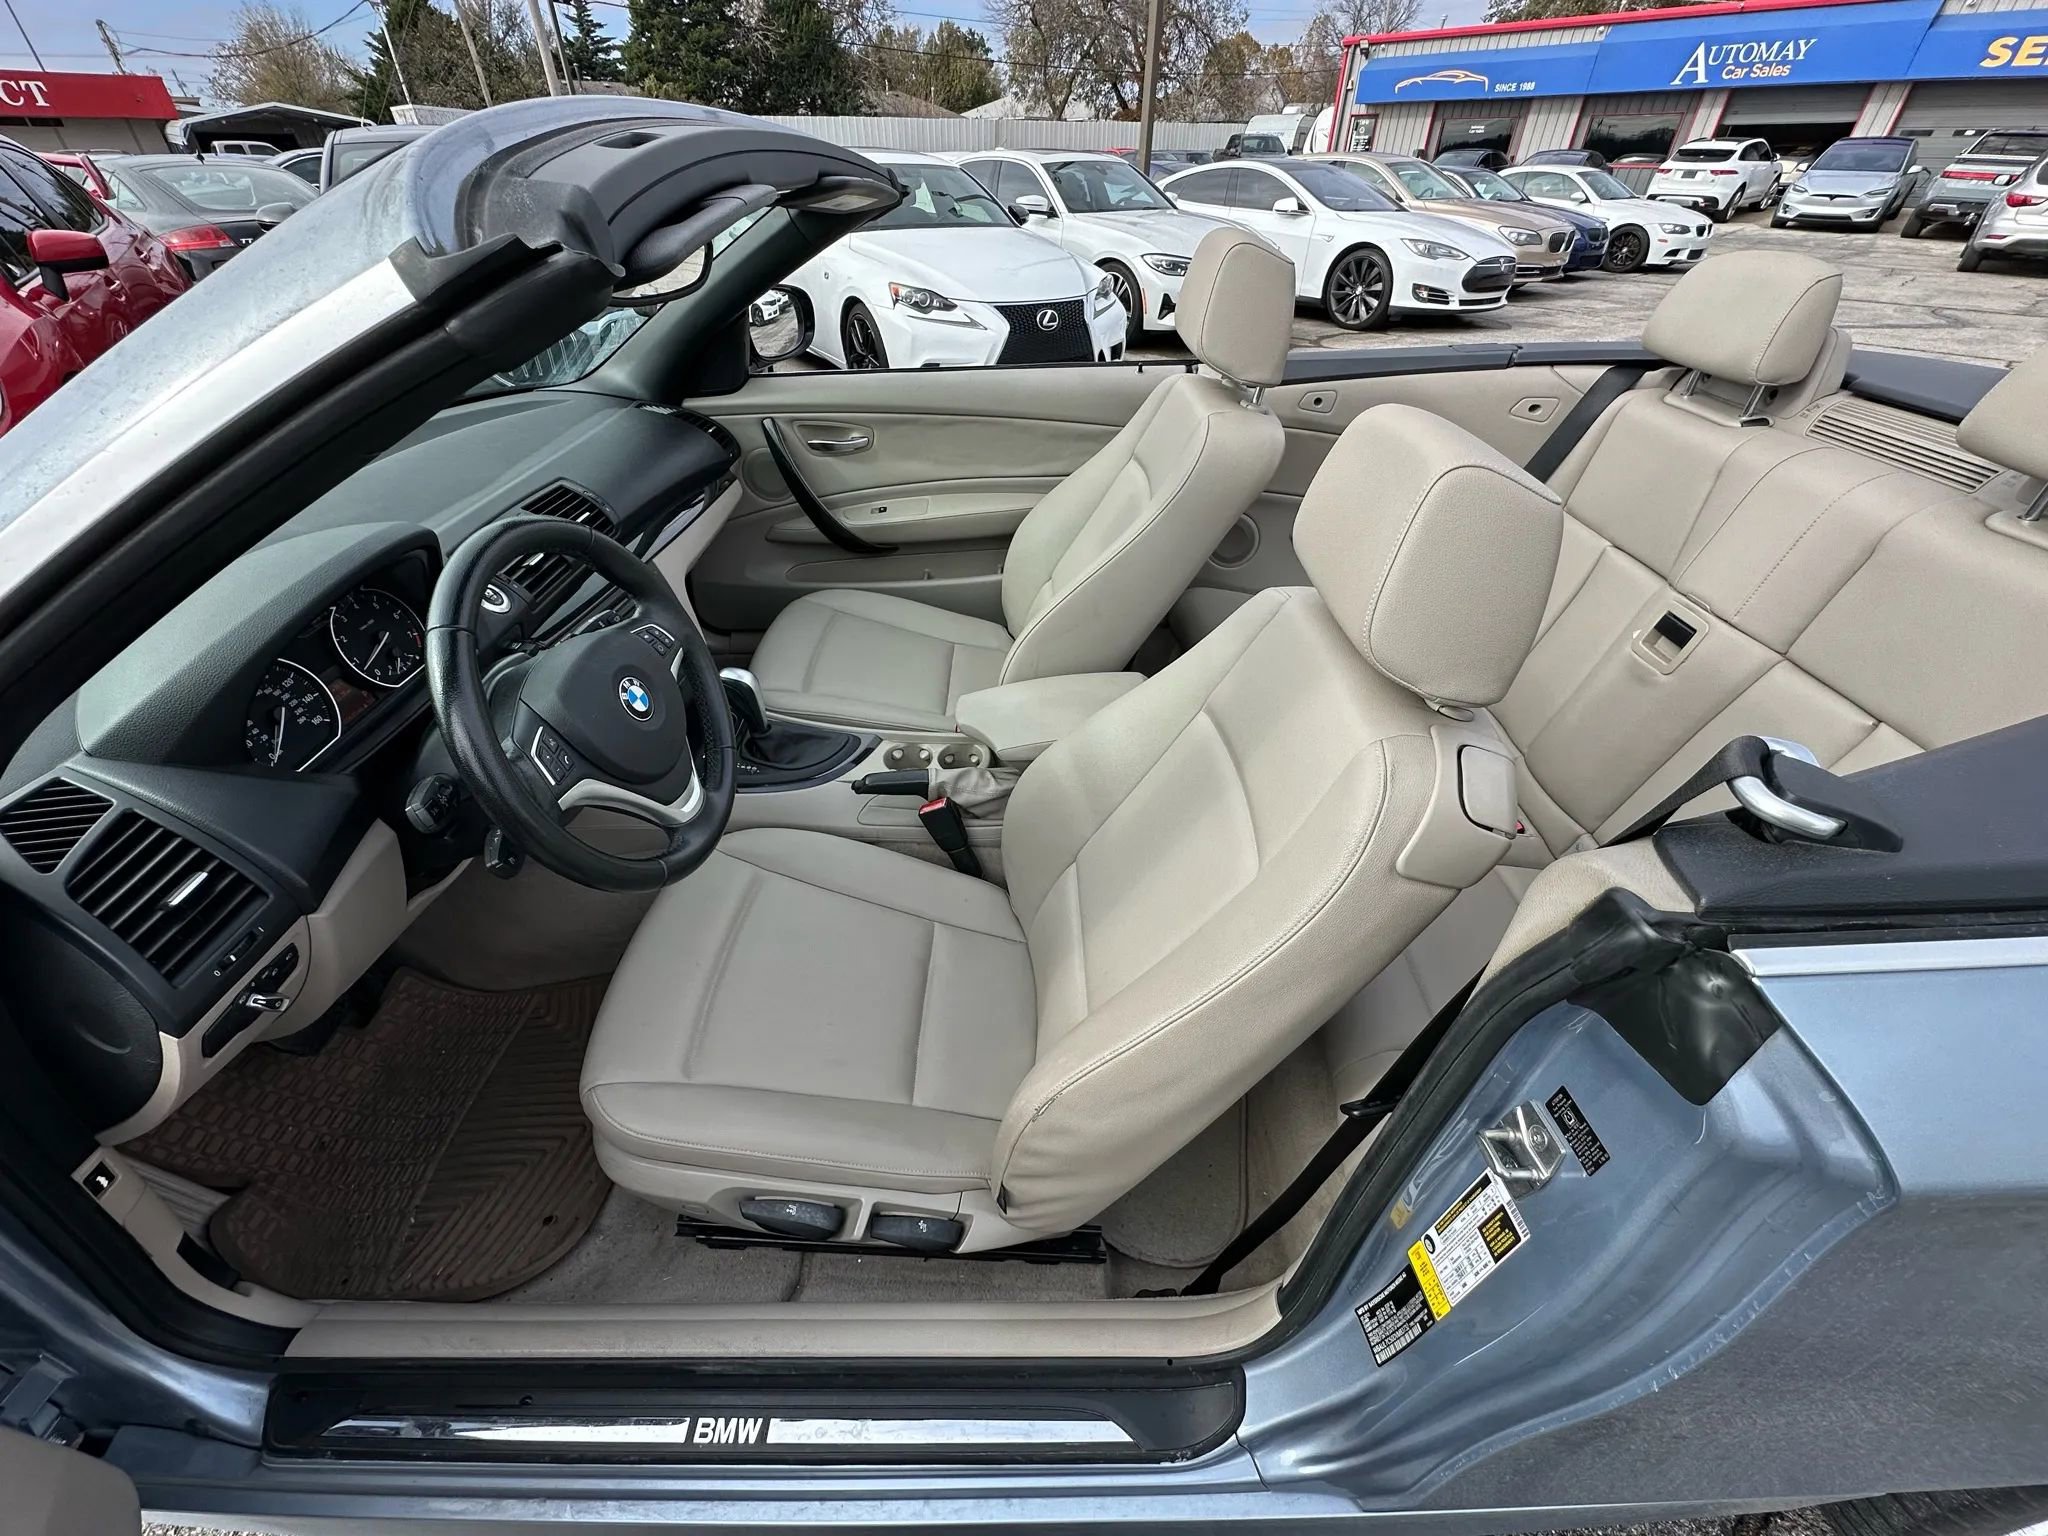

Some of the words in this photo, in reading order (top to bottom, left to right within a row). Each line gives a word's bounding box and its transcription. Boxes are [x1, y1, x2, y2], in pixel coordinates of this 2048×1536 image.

[1980, 36, 2048, 67] SE
[1670, 38, 1818, 85] AUTOMAY
[1721, 65, 1749, 80] Car
[1750, 62, 1792, 78] Sales
[0, 80, 50, 106] CT
[1494, 82, 1517, 92] SINCE
[282, 677, 294, 688] 120
[302, 694, 314, 704] 140
[311, 715, 323, 725] 160
[693, 1417, 763, 1444] BMW
